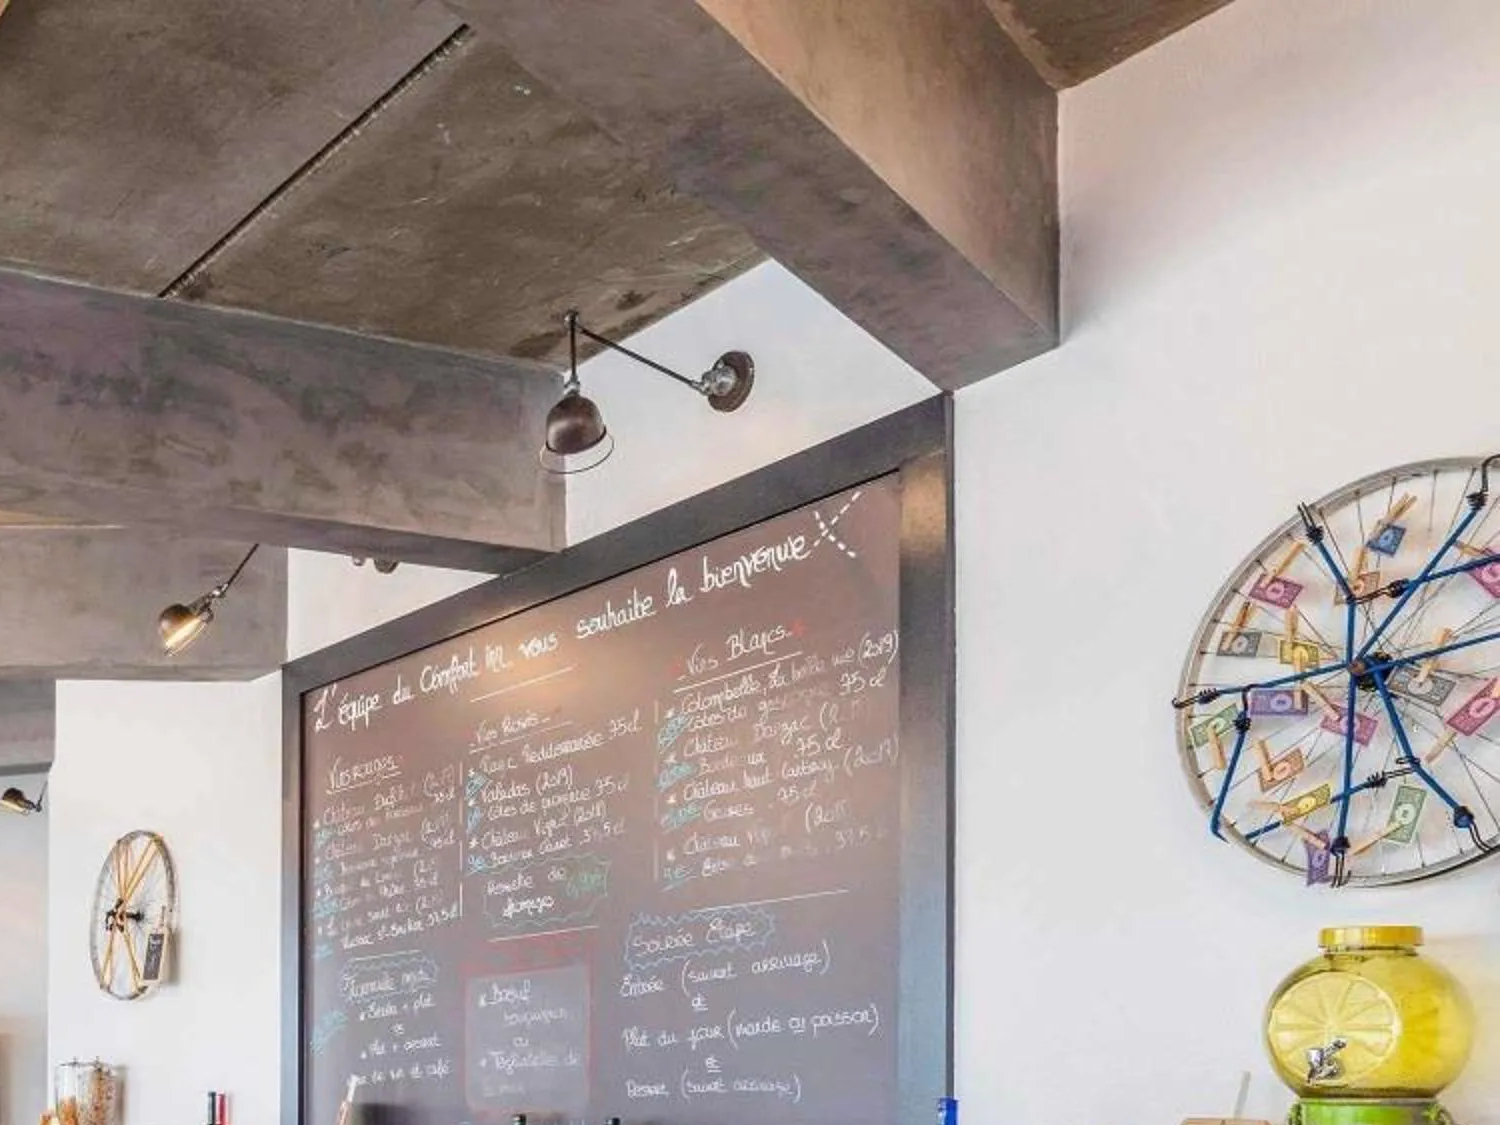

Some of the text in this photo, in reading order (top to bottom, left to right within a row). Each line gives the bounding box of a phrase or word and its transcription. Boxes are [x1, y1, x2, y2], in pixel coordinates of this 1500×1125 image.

[393, 675, 414, 705] du
[518, 632, 558, 657] vous
[576, 587, 656, 639] souhaite
[665, 567, 693, 608] la
[700, 535, 811, 592] bienvenue
